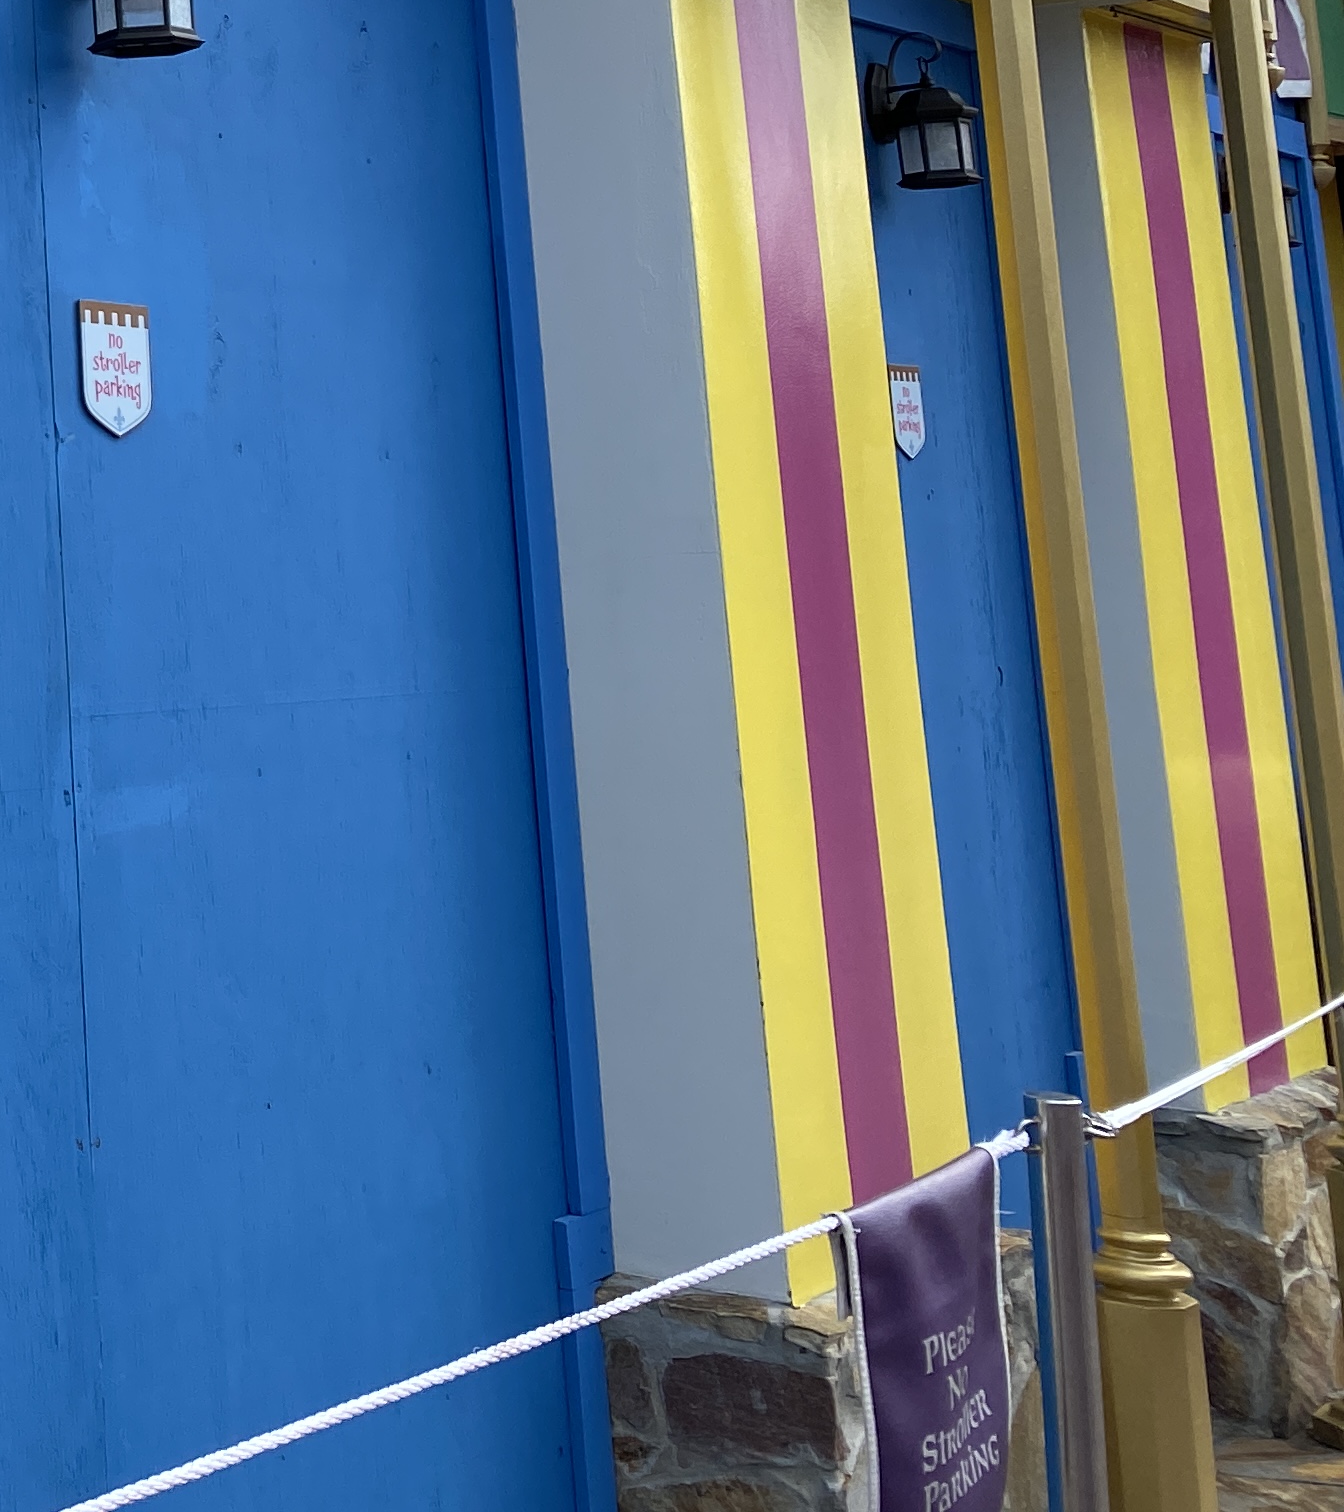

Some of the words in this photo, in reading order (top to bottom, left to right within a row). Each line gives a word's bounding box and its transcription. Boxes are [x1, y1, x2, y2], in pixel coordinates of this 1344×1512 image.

[108, 332, 123, 349] no
[92, 350, 141, 375] stroller
[94, 375, 141, 410] parking
